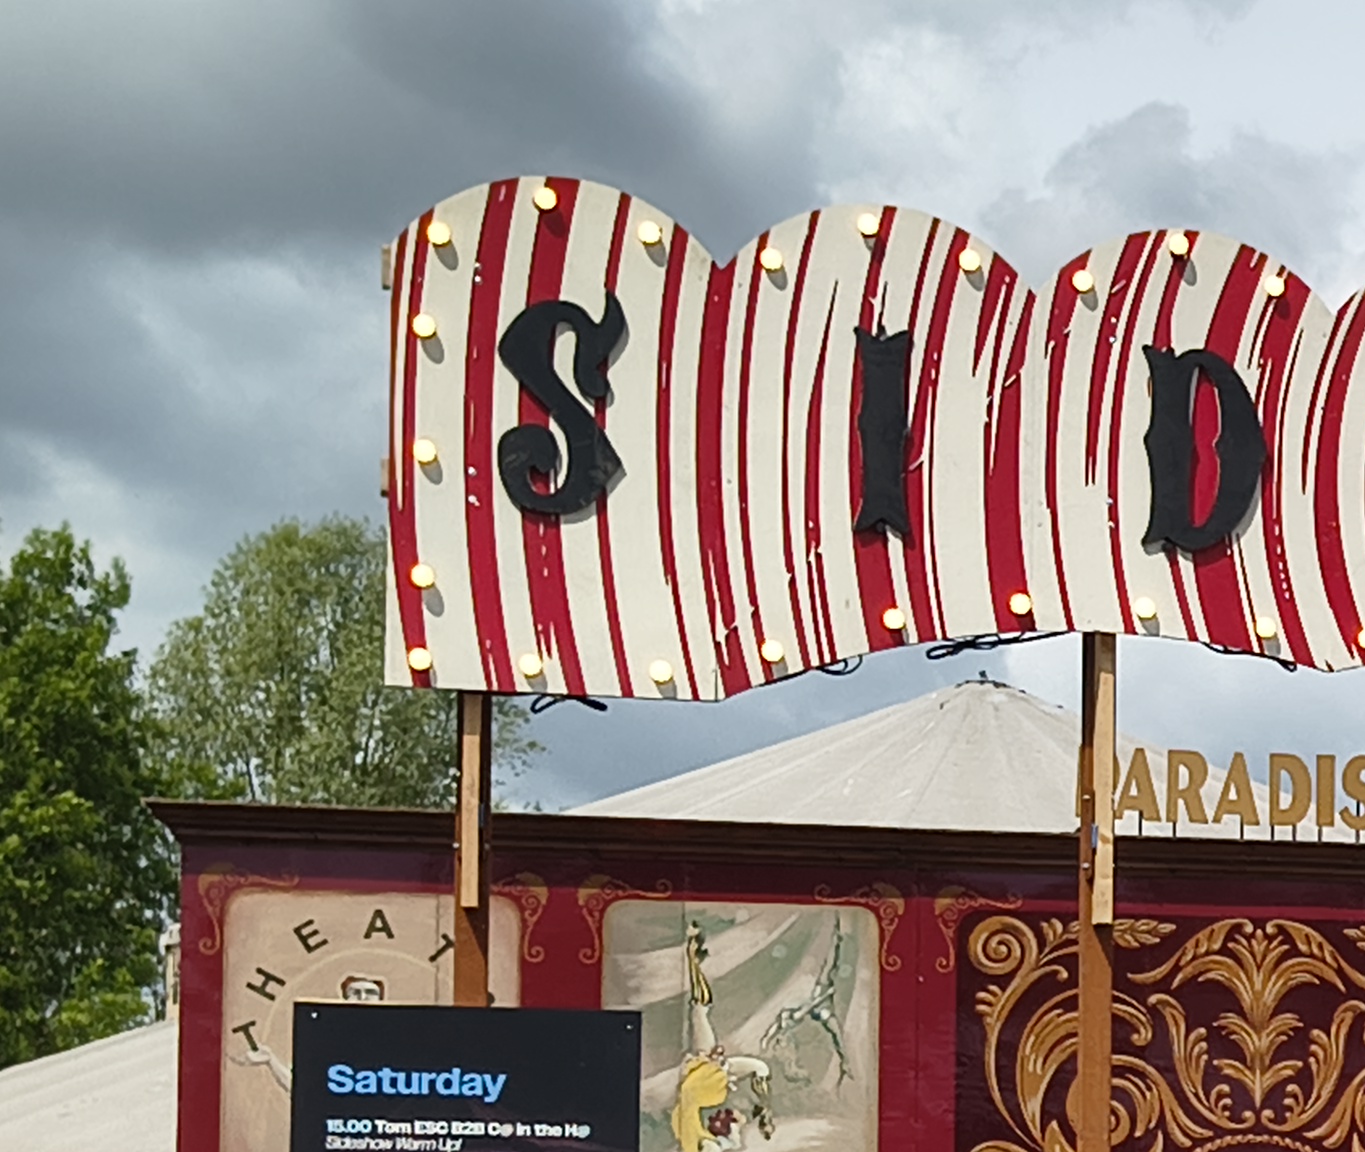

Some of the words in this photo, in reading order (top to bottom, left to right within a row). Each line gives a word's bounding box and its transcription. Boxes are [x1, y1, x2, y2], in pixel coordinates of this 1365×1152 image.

[232, 908, 495, 1052] THEAT
[326, 1064, 507, 1103] Saturday
[325, 1119, 372, 1134] 15.00
[374, 1120, 412, 1135] Tom
[516, 1121, 531, 1136] in
[534, 1123, 562, 1137] the
[325, 1135, 394, 1151] Sideshow
[395, 1137, 437, 1151] Warm
